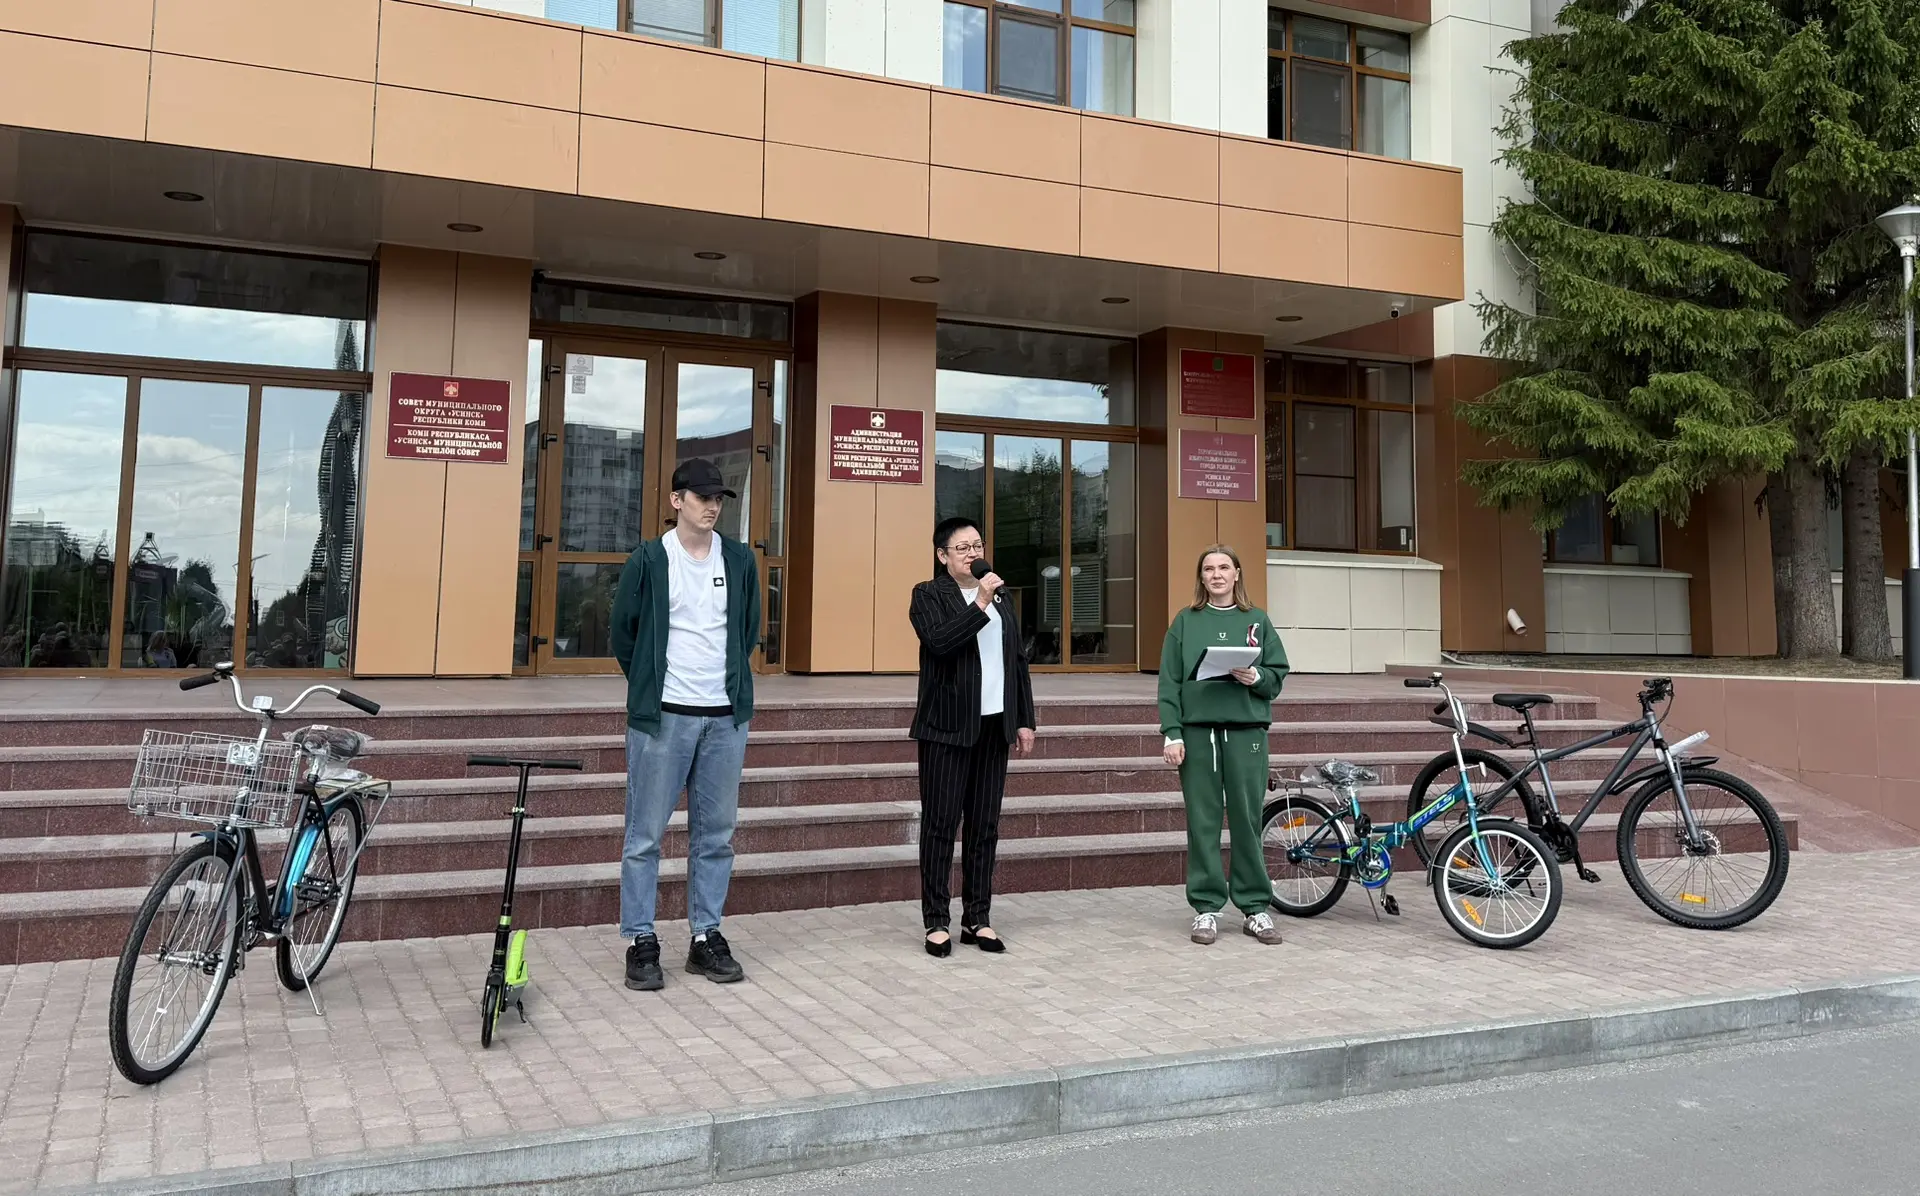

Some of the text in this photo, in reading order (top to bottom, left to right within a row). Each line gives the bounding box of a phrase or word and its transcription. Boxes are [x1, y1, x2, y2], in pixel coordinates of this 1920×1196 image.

[398, 398, 502, 412] СОВЕТ МУНИЦИПАЛЬНОГО
[414, 407, 446, 416] ОКРУГА
[412, 415, 486, 427] РЕСПУБЛИКИ КОМИ
[407, 429, 490, 441] КОМИ РЕСПУБЛИКАСА
[851, 430, 902, 438] АДМИНИСТРАЦИЯ
[834, 436, 894, 445] МУНИЦИПАЛЬНОГО
[851, 469, 902, 477] АДМИНИСТРАЦИЯ
[1413, 793, 1453, 828] STELS
